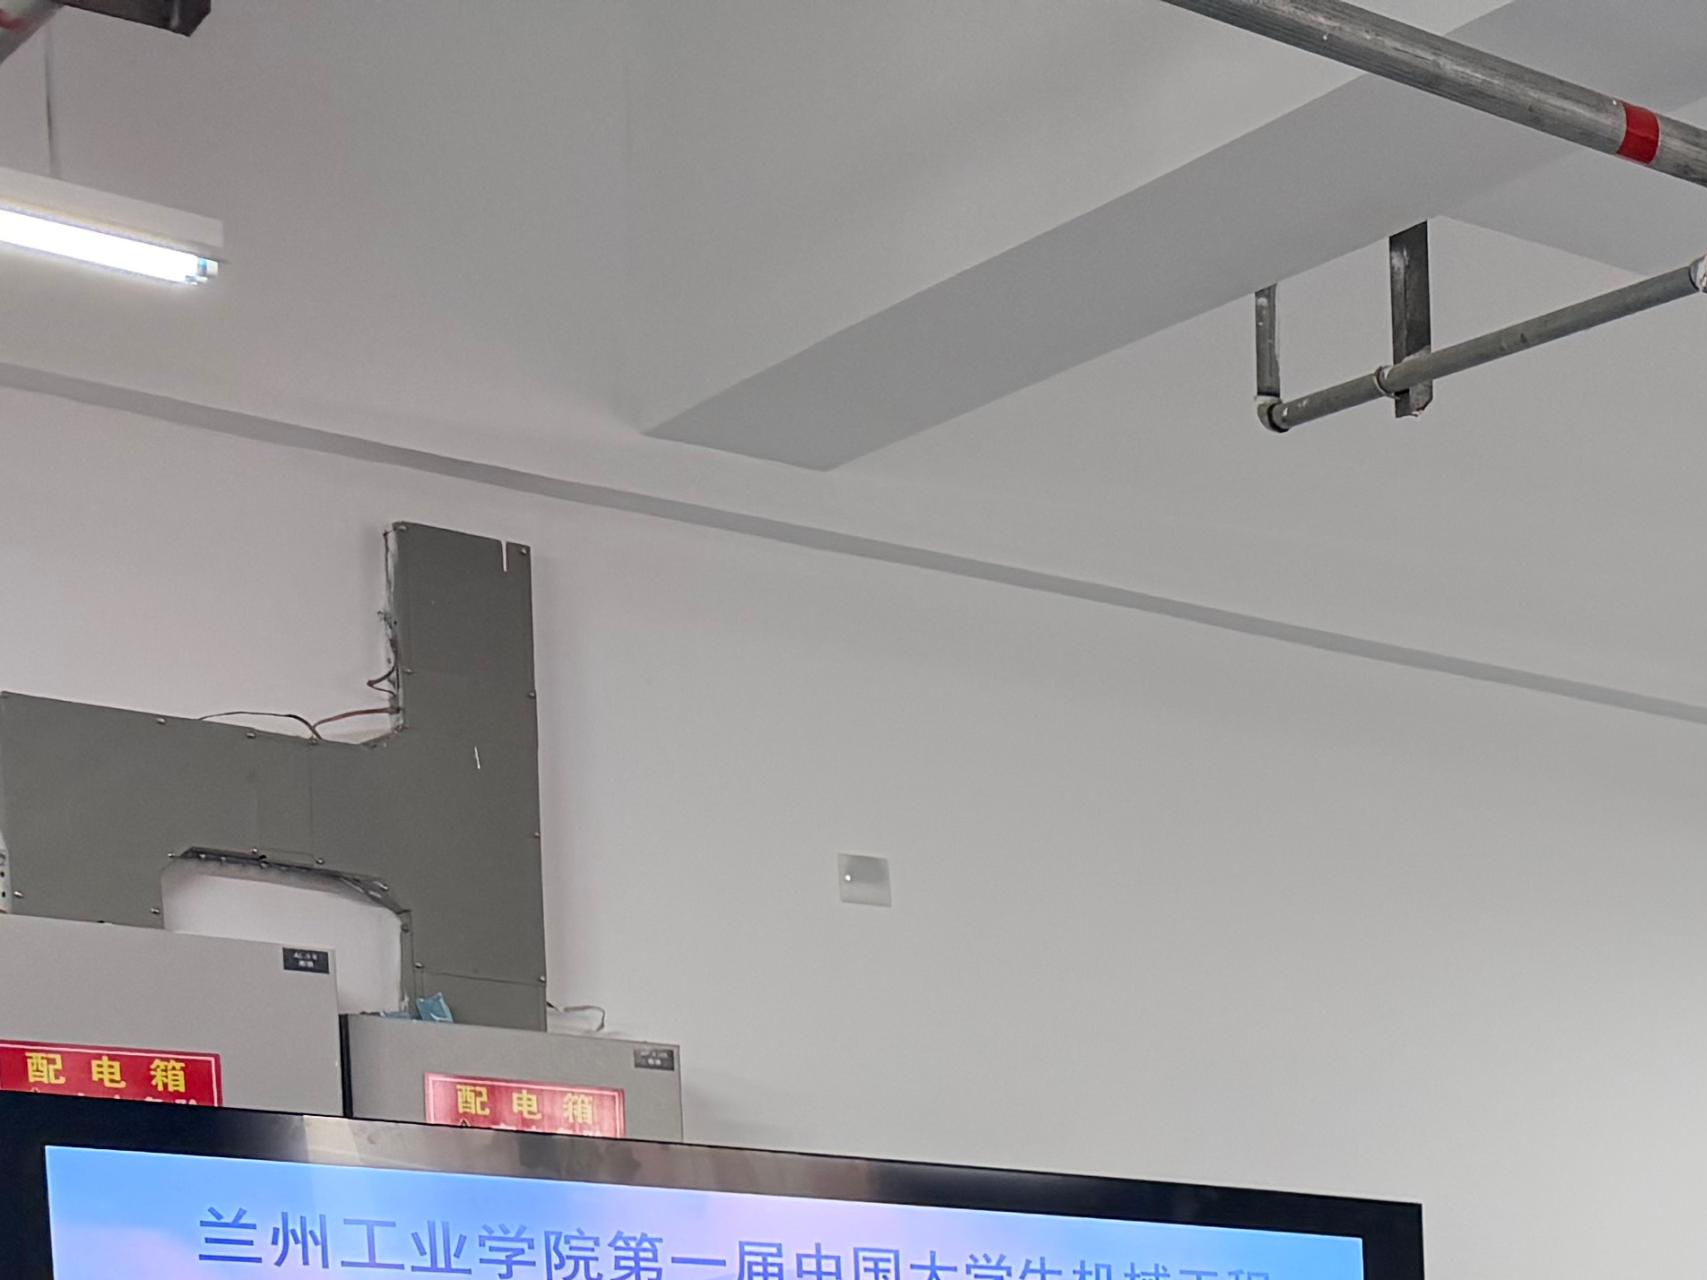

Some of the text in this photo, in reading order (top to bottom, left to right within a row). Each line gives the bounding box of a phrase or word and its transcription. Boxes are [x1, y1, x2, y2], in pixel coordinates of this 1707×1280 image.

[25, 1051, 187, 1093] 配电箱
[455, 1084, 594, 1126] 配电箱
